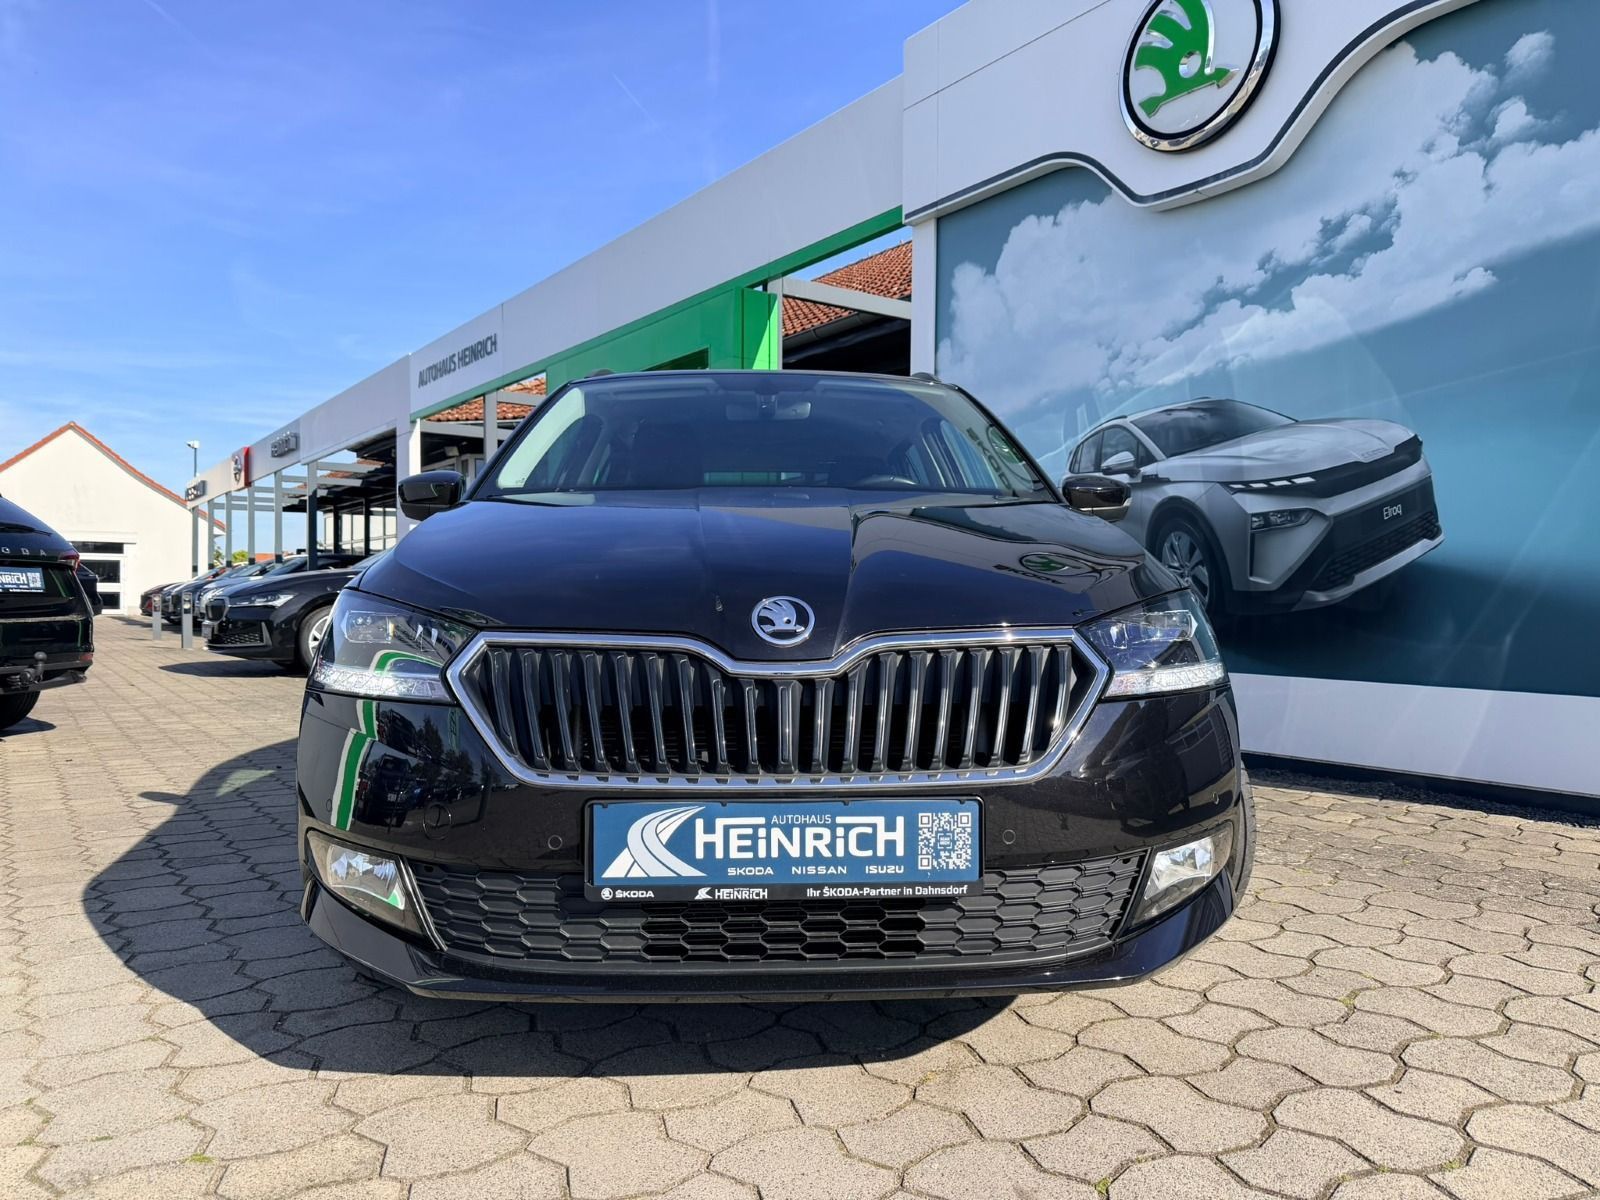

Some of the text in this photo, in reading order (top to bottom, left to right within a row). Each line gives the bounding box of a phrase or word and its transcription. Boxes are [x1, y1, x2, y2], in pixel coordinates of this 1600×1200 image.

[418, 333, 497, 388] AUTOHAUS HEINRICH
[1383, 504, 1402, 519] Elroq
[771, 814, 831, 825] AUTOHAUS
[792, 865, 847, 875] NISSAN
[865, 865, 904, 874] ISUZU
[806, 884, 969, 897] Ihr ŠKODA-Partner in Dahnsdorf
